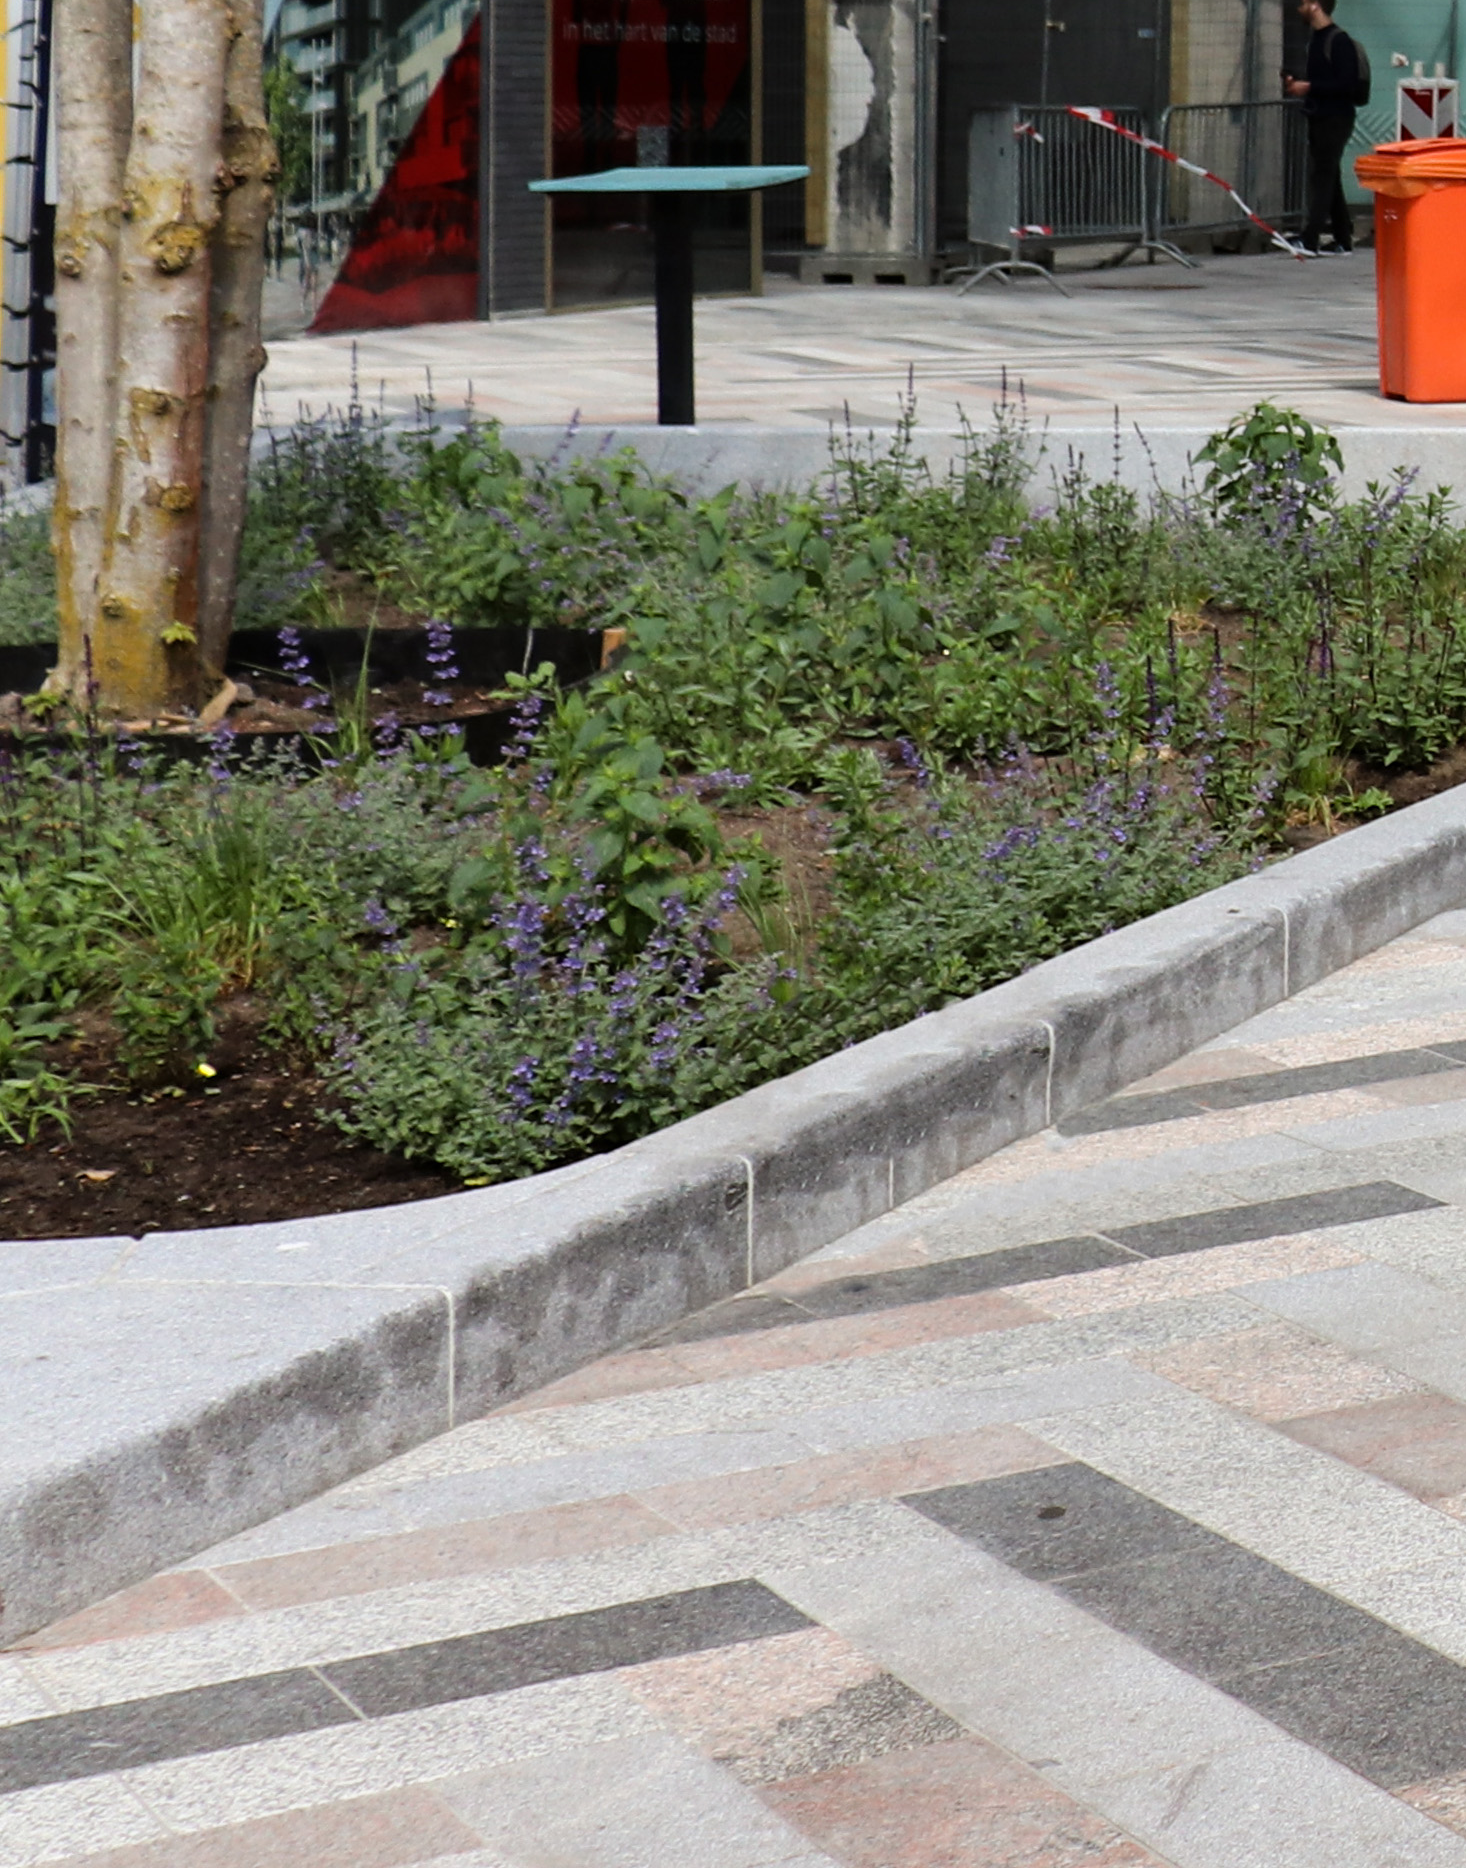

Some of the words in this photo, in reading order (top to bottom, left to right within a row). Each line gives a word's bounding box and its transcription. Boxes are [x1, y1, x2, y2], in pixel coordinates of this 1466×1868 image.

[582, 19, 611, 42] het
[681, 20, 701, 43] de
[705, 22, 737, 44] stad
